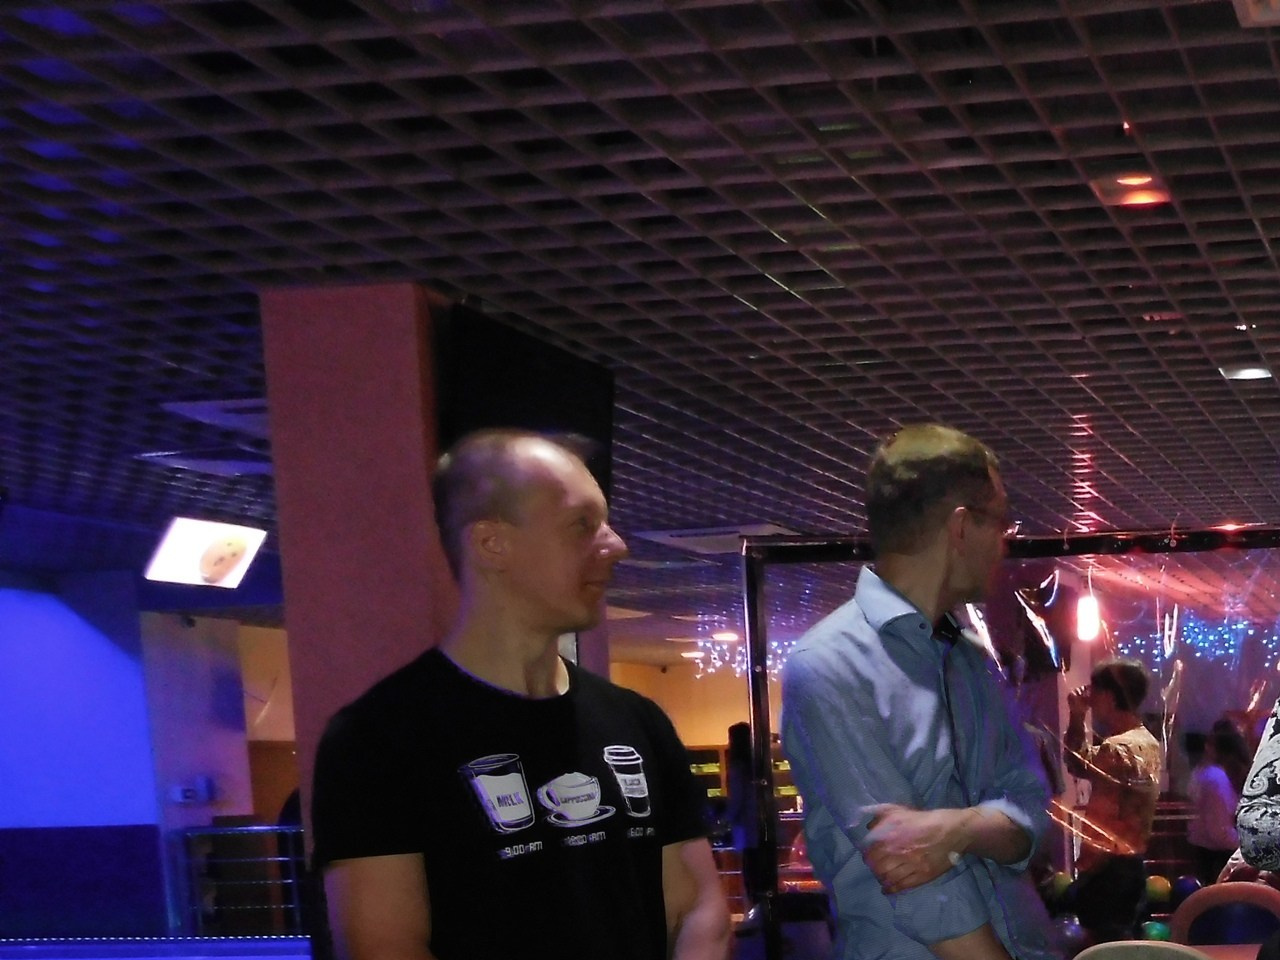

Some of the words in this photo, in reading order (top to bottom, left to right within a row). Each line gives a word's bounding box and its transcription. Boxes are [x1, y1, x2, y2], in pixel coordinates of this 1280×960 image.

[497, 792, 524, 808] MILK
[504, 844, 526, 857] 9:00
[527, 841, 543, 852] AM
